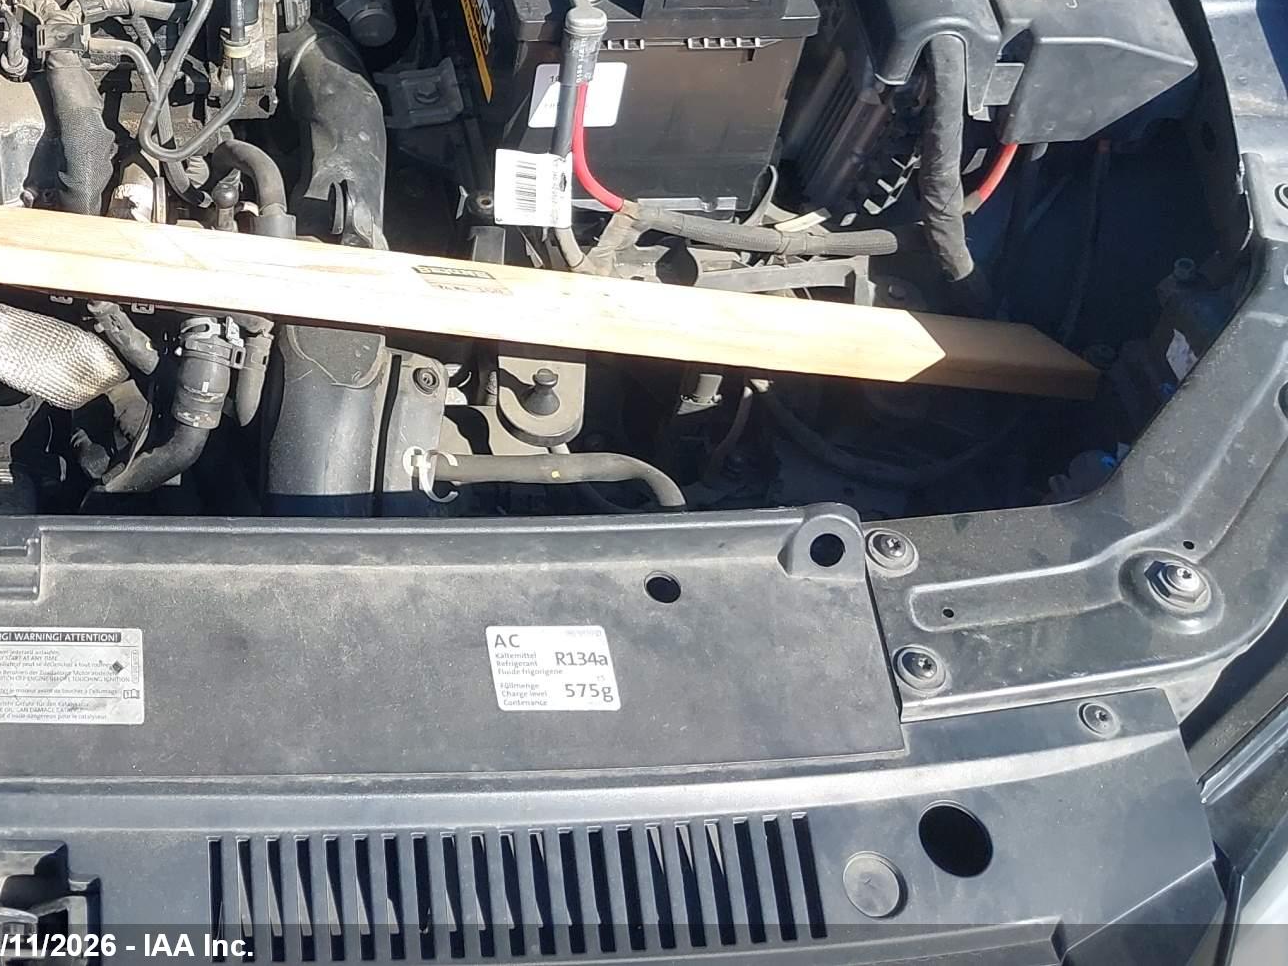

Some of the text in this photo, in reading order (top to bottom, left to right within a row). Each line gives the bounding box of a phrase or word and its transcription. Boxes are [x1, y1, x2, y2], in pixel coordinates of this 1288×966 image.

[14, 632, 61, 642] WARNING!
[64, 633, 118, 642] ATTENTION!
[555, 651, 609, 666] R134a
[496, 660, 538, 668] Refrigerant
[501, 690, 528, 698] Charge
